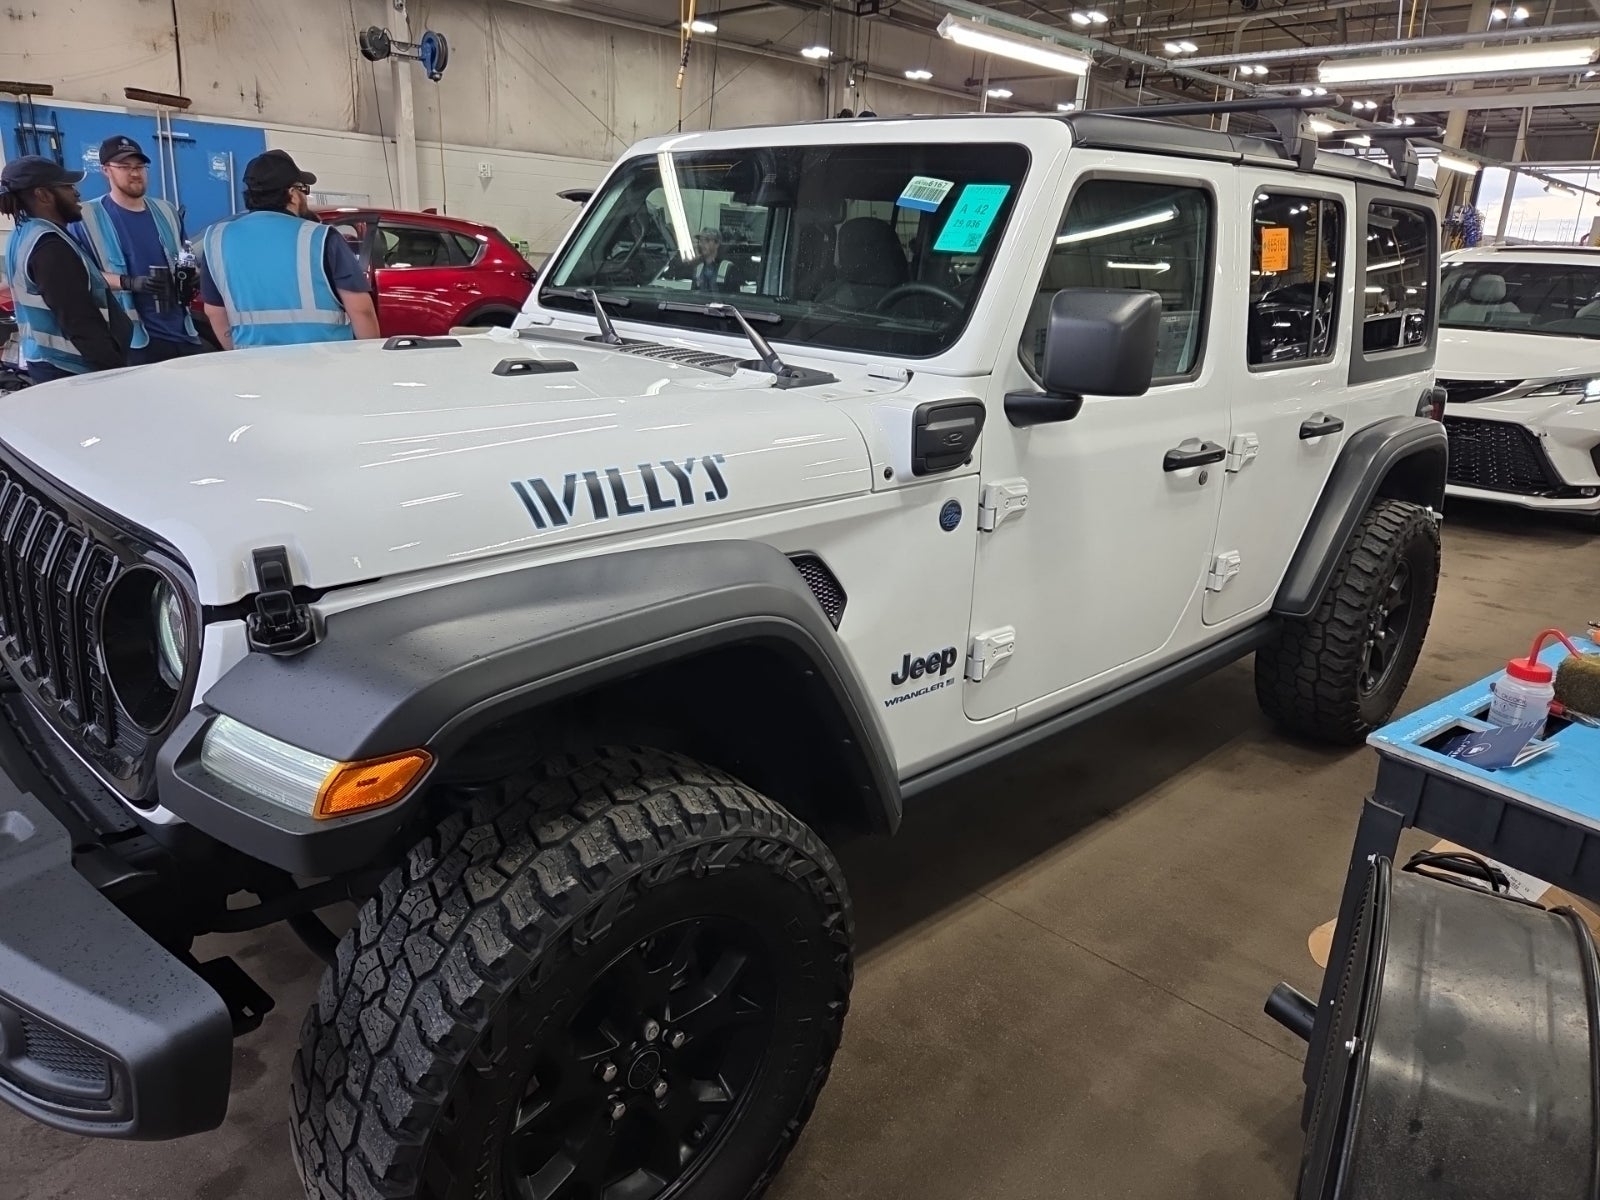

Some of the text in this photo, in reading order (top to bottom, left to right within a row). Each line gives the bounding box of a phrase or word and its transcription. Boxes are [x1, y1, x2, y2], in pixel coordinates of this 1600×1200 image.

[960, 203, 989, 215] A 42
[510, 454, 729, 529] WILLYS
[891, 646, 957, 685] Jeep
[884, 681, 944, 707] WRANGLER
